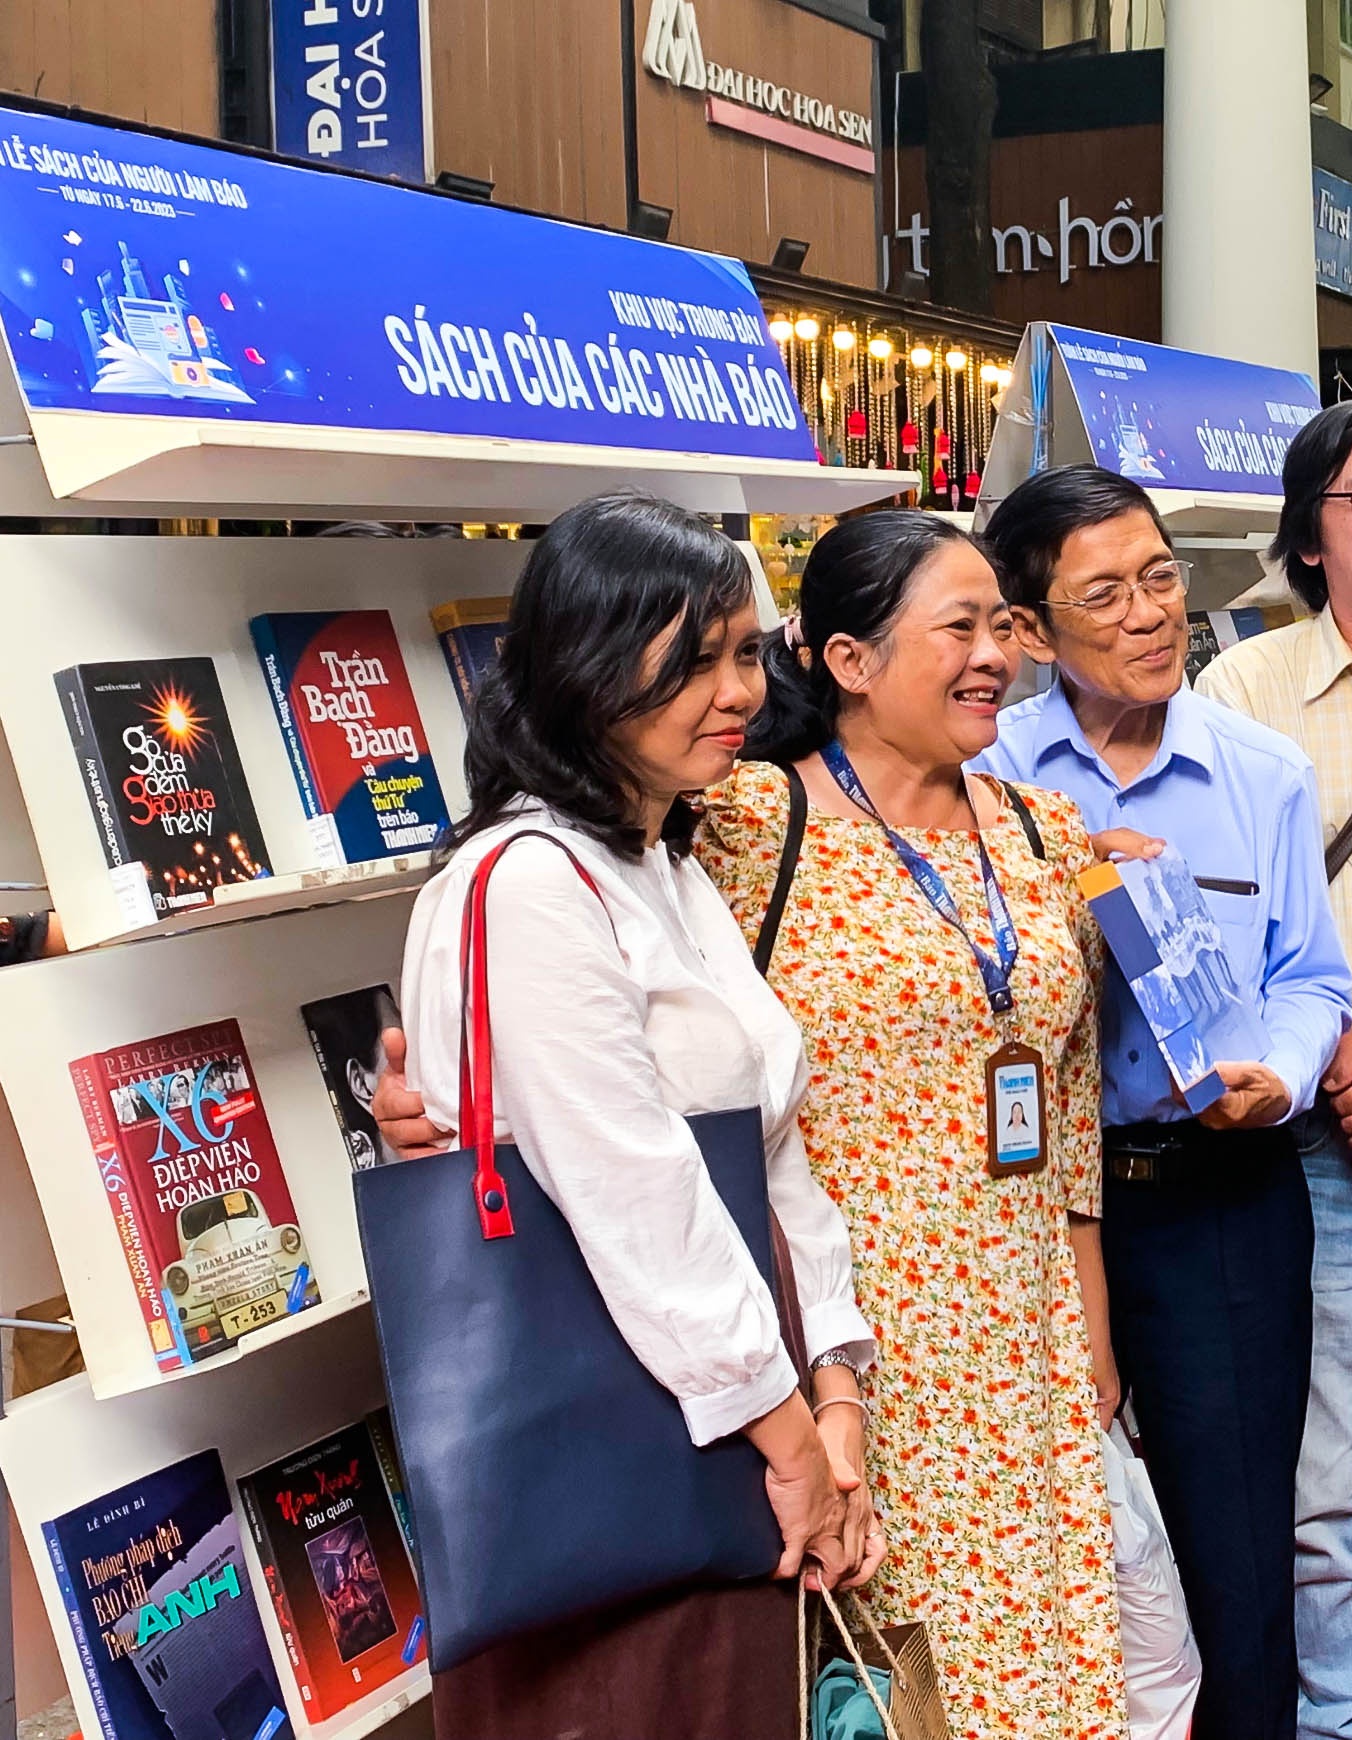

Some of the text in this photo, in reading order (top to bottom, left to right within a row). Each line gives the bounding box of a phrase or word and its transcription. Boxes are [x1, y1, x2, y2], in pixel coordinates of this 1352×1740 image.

[305, 44, 350, 157] ĐẠI
[354, 30, 389, 148] HOA
[793, 92, 837, 133] HOA
[838, 110, 872, 145] SEN
[29, 143, 84, 180] SÁCH
[82, 150, 123, 188] CỦA
[119, 163, 178, 197] NGƯỜI
[175, 170, 214, 203] LÀM
[210, 178, 248, 209] BÁO
[608, 290, 651, 329] KHU
[649, 298, 685, 340] VỰC
[733, 306, 765, 347] BÀY
[383, 303, 797, 431] SÁCH CỦA CÁC NHÀ BÁO
[1196, 418, 1243, 473] SÁCH
[1235, 417, 1270, 475] CỦA
[319, 650, 389, 688] Trần
[104, 1037, 194, 1075] PERFECT
[129, 1061, 235, 1164] X6
[95, 1149, 129, 1194] X6
[137, 1563, 242, 1648] ANH
